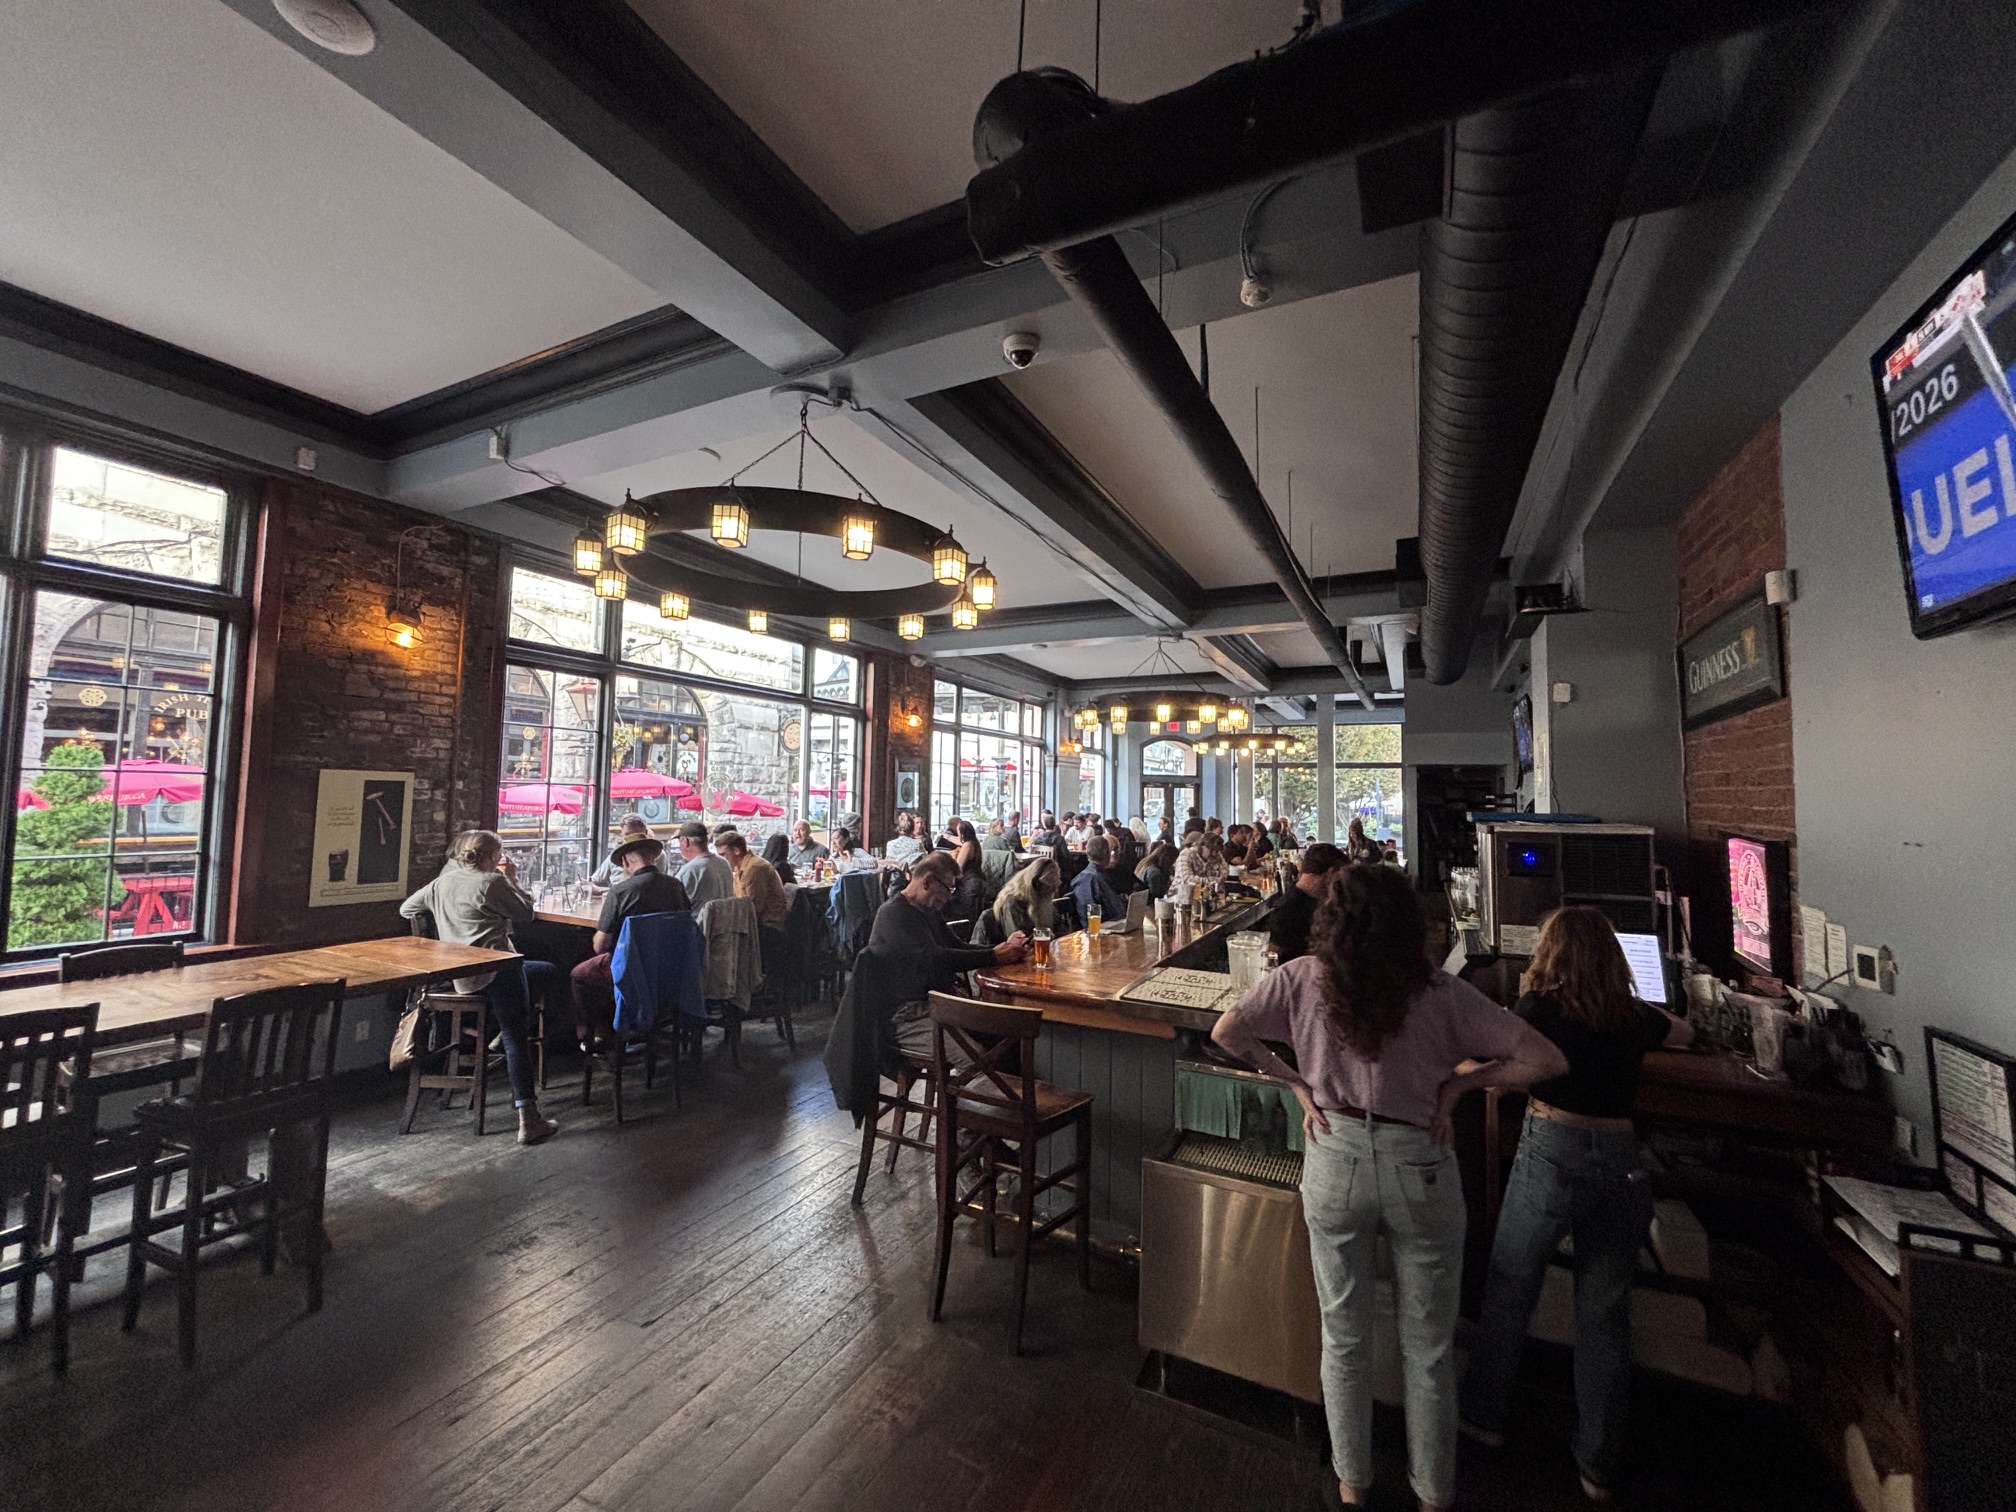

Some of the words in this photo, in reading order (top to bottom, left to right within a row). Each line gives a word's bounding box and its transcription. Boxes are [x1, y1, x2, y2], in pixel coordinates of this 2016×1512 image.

[1689, 641, 1740, 694] GUINNESS
[154, 693, 189, 714] IRISH
[175, 708, 209, 720] PUB
